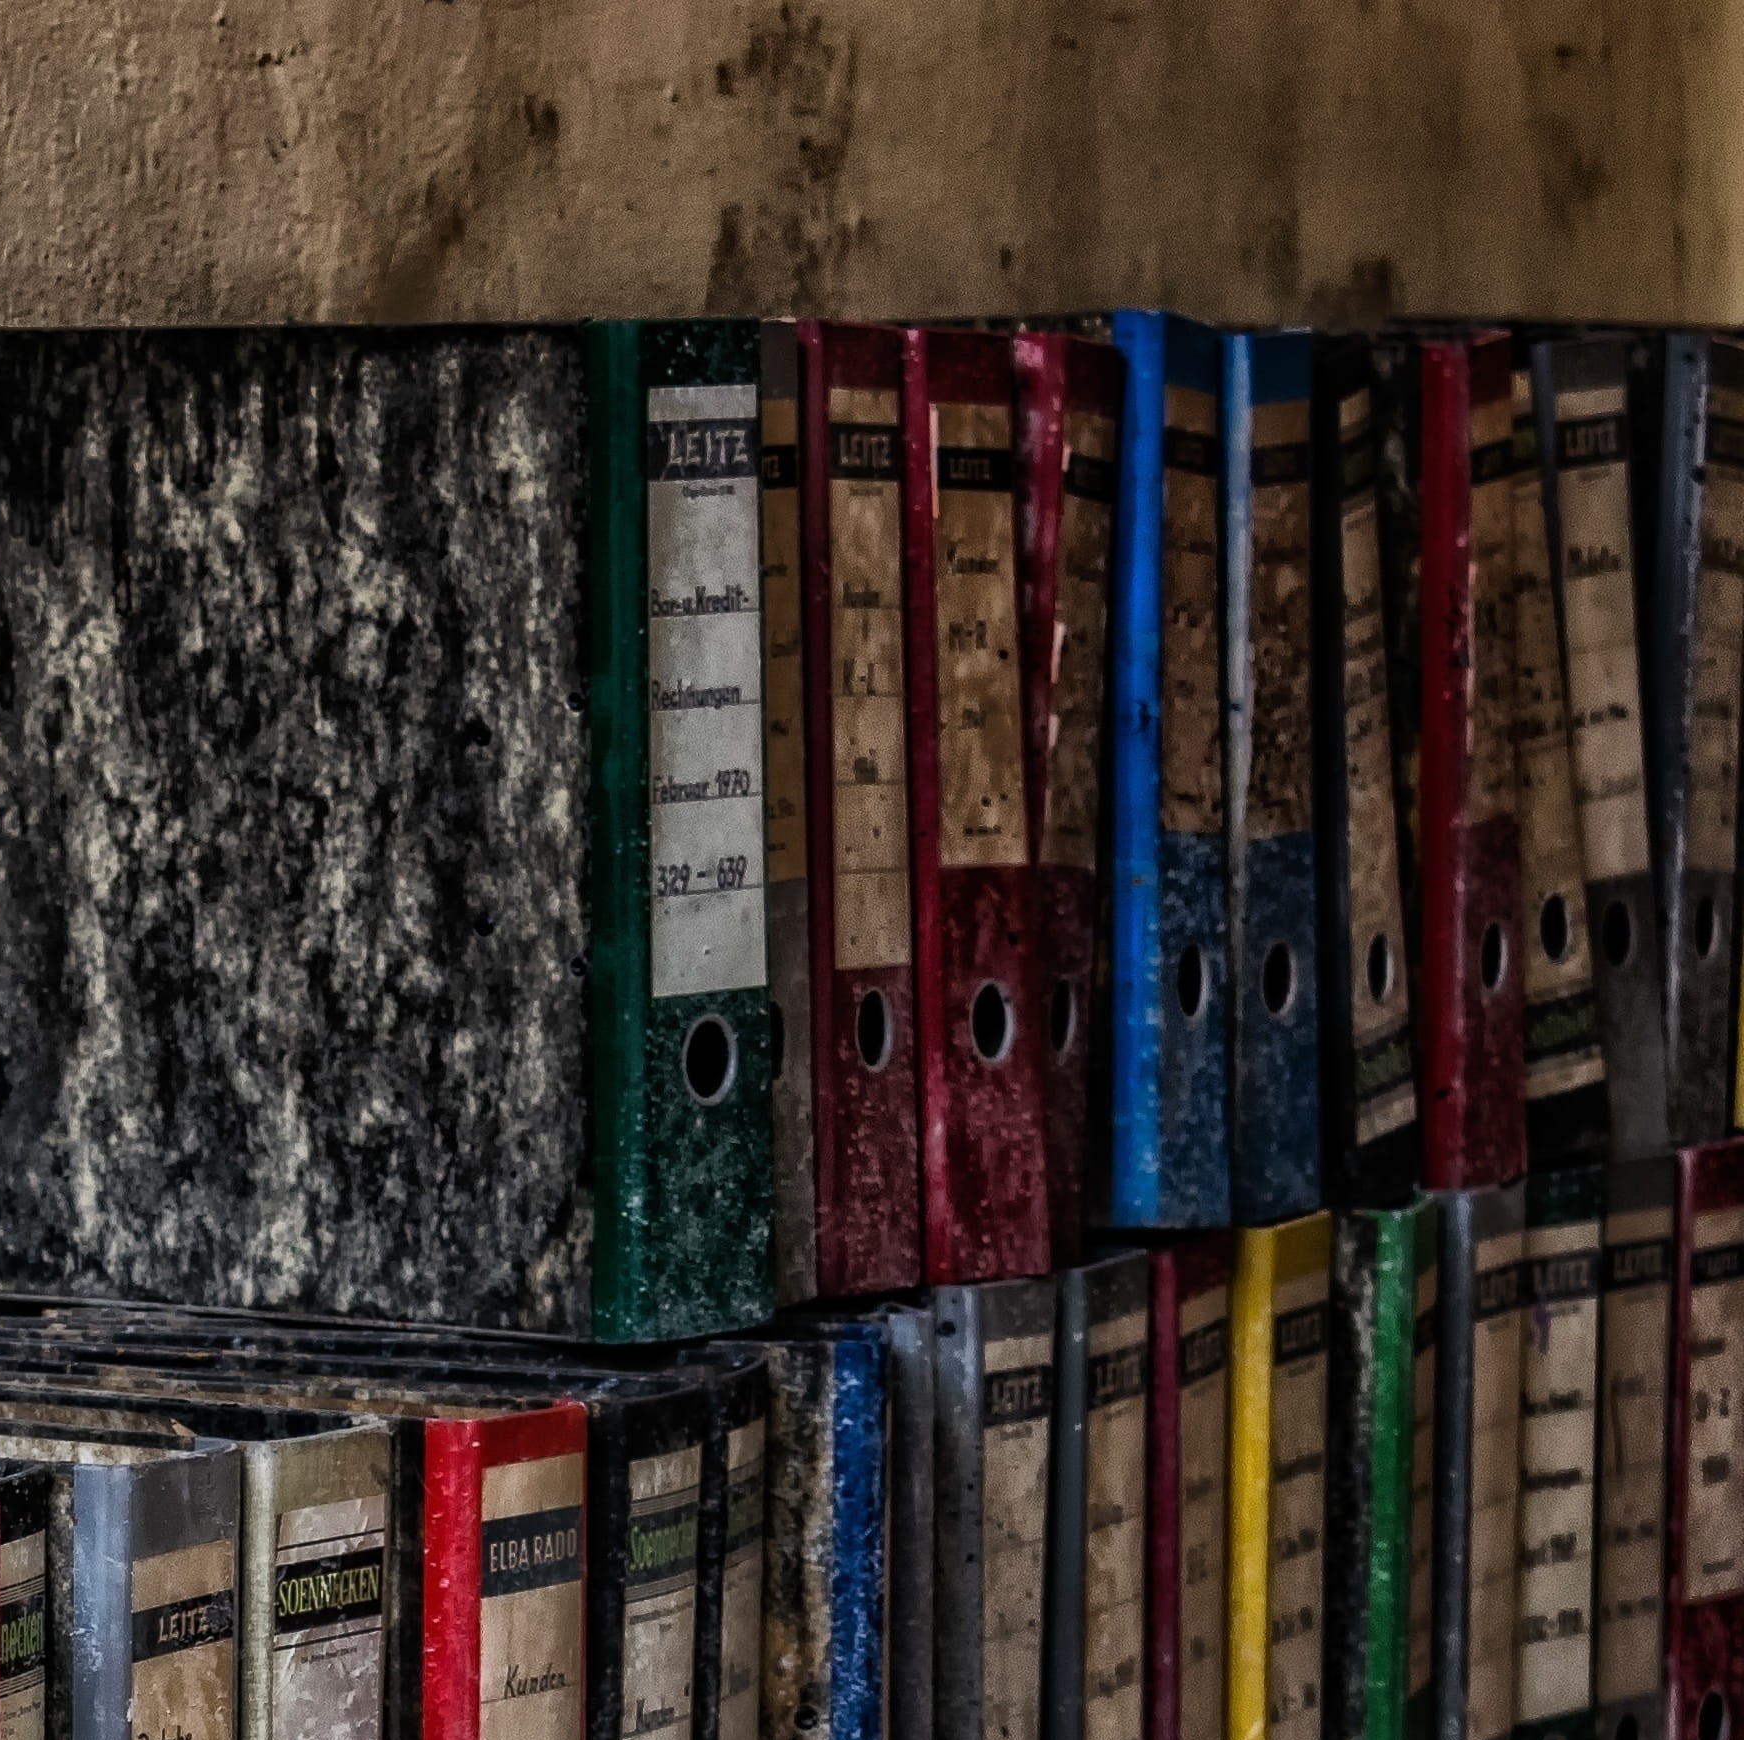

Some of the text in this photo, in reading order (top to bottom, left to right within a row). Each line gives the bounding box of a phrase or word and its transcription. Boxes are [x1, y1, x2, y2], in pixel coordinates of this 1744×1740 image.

[667, 429, 749, 467] LEITZ
[652, 679, 741, 711] Rechnungen
[489, 1529, 577, 1575] ELBA RADO
[278, 1563, 382, 1617] SOENNECKEN
[157, 1604, 211, 1644] LEITZ
[503, 1662, 567, 1700] Kunden
